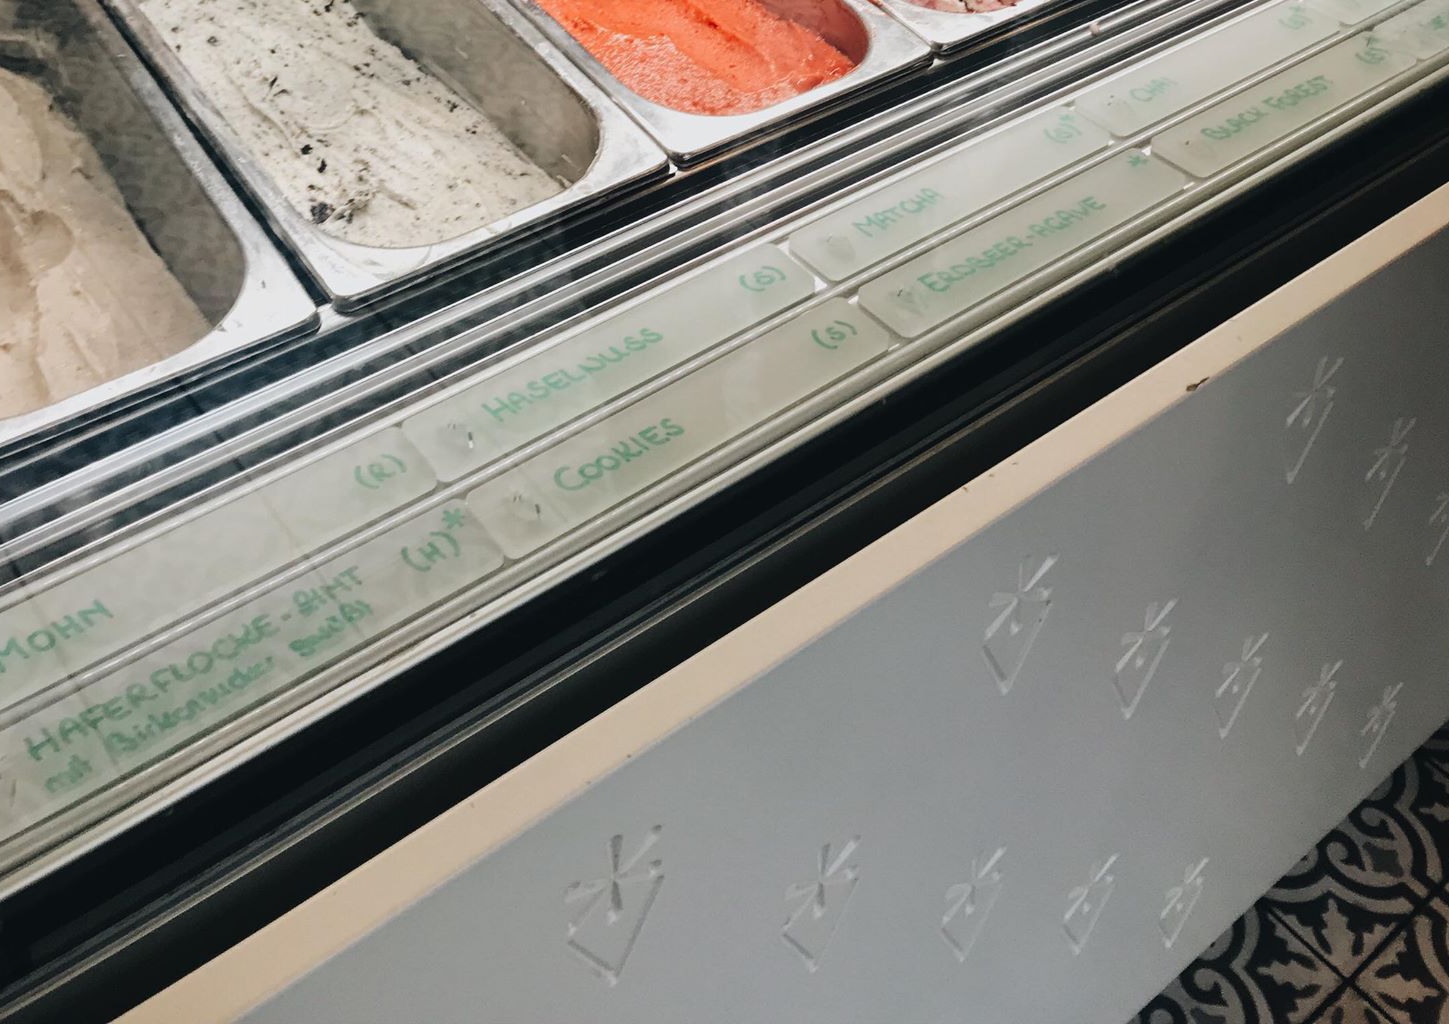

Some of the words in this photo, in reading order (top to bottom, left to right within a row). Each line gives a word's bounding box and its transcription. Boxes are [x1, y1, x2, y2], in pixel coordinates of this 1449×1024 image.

[852, 186, 943, 239] MATCHA
[917, 196, 1107, 294] ERDBEER-AGAVE
[482, 328, 664, 422] HASELNUSS
[553, 417, 686, 492] COOKIES
